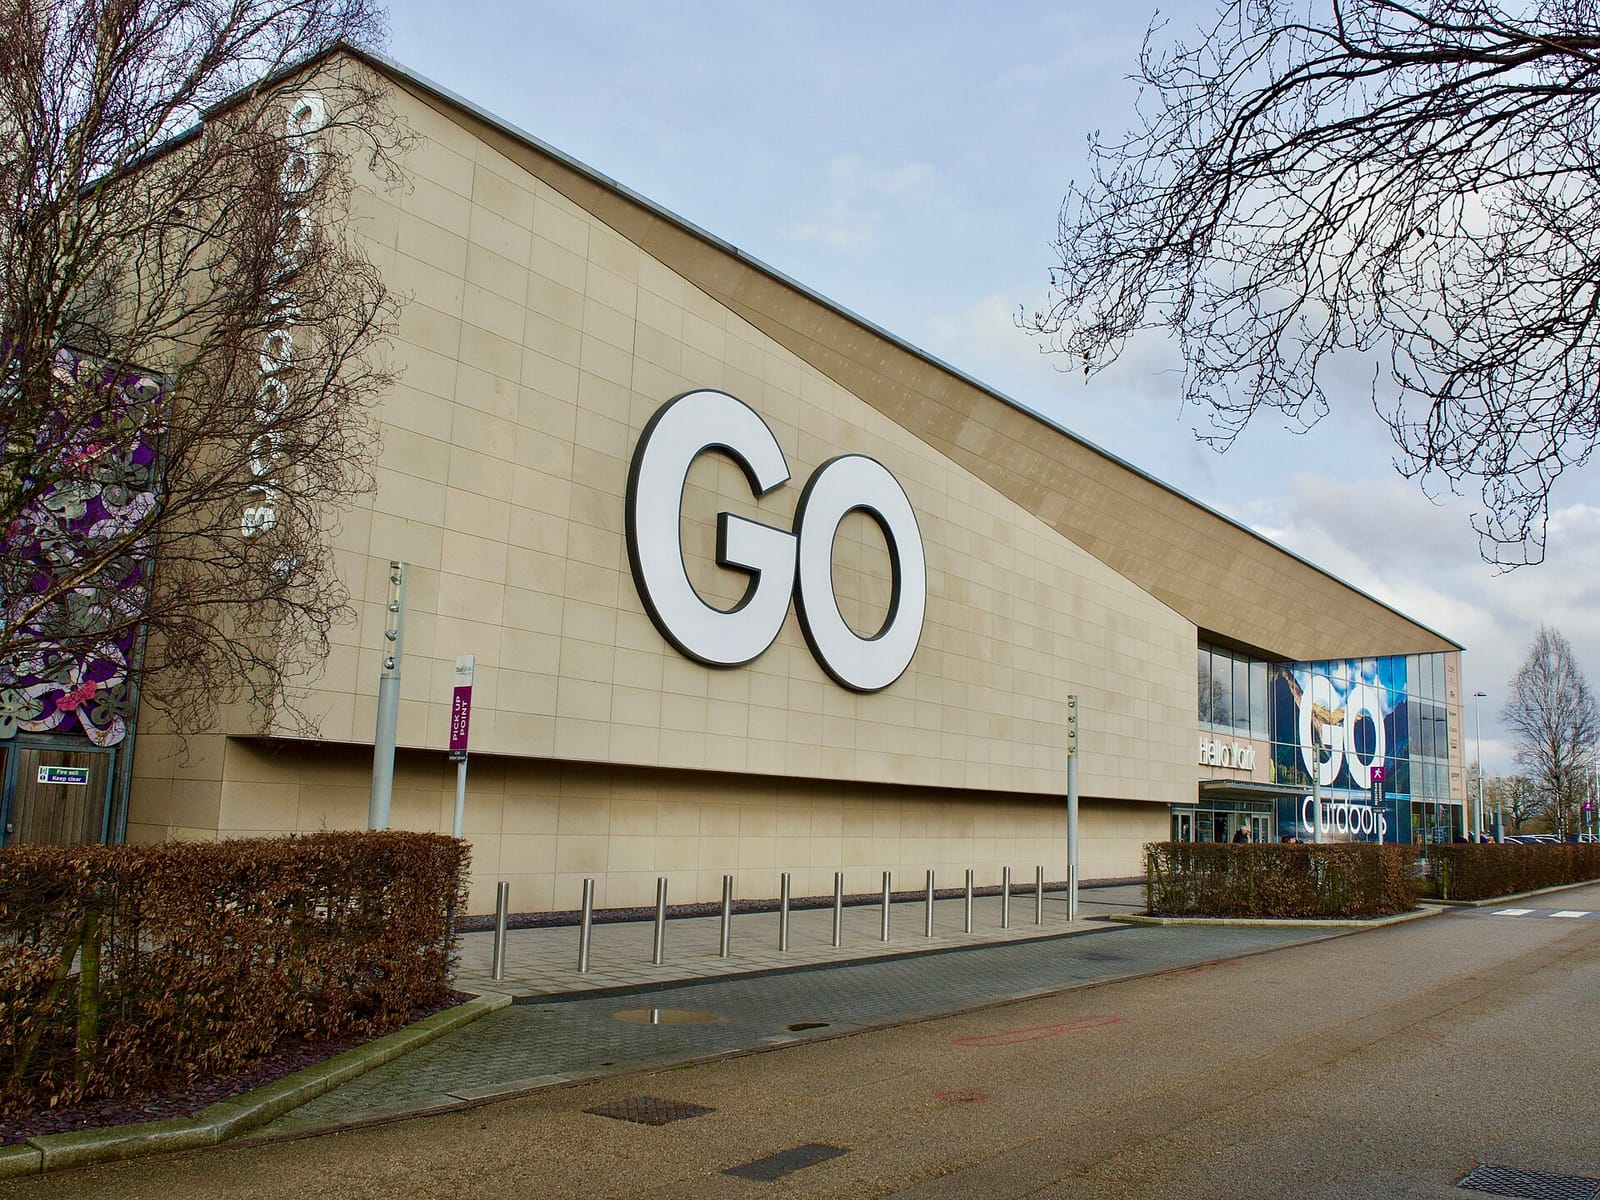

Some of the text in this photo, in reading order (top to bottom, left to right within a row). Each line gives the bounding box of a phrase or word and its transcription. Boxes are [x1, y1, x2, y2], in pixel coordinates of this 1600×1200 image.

[625, 388, 927, 692] GO
[455, 696, 461, 711] UP
[1299, 675, 1386, 789] GO
[1199, 736, 1256, 770] Hello York
